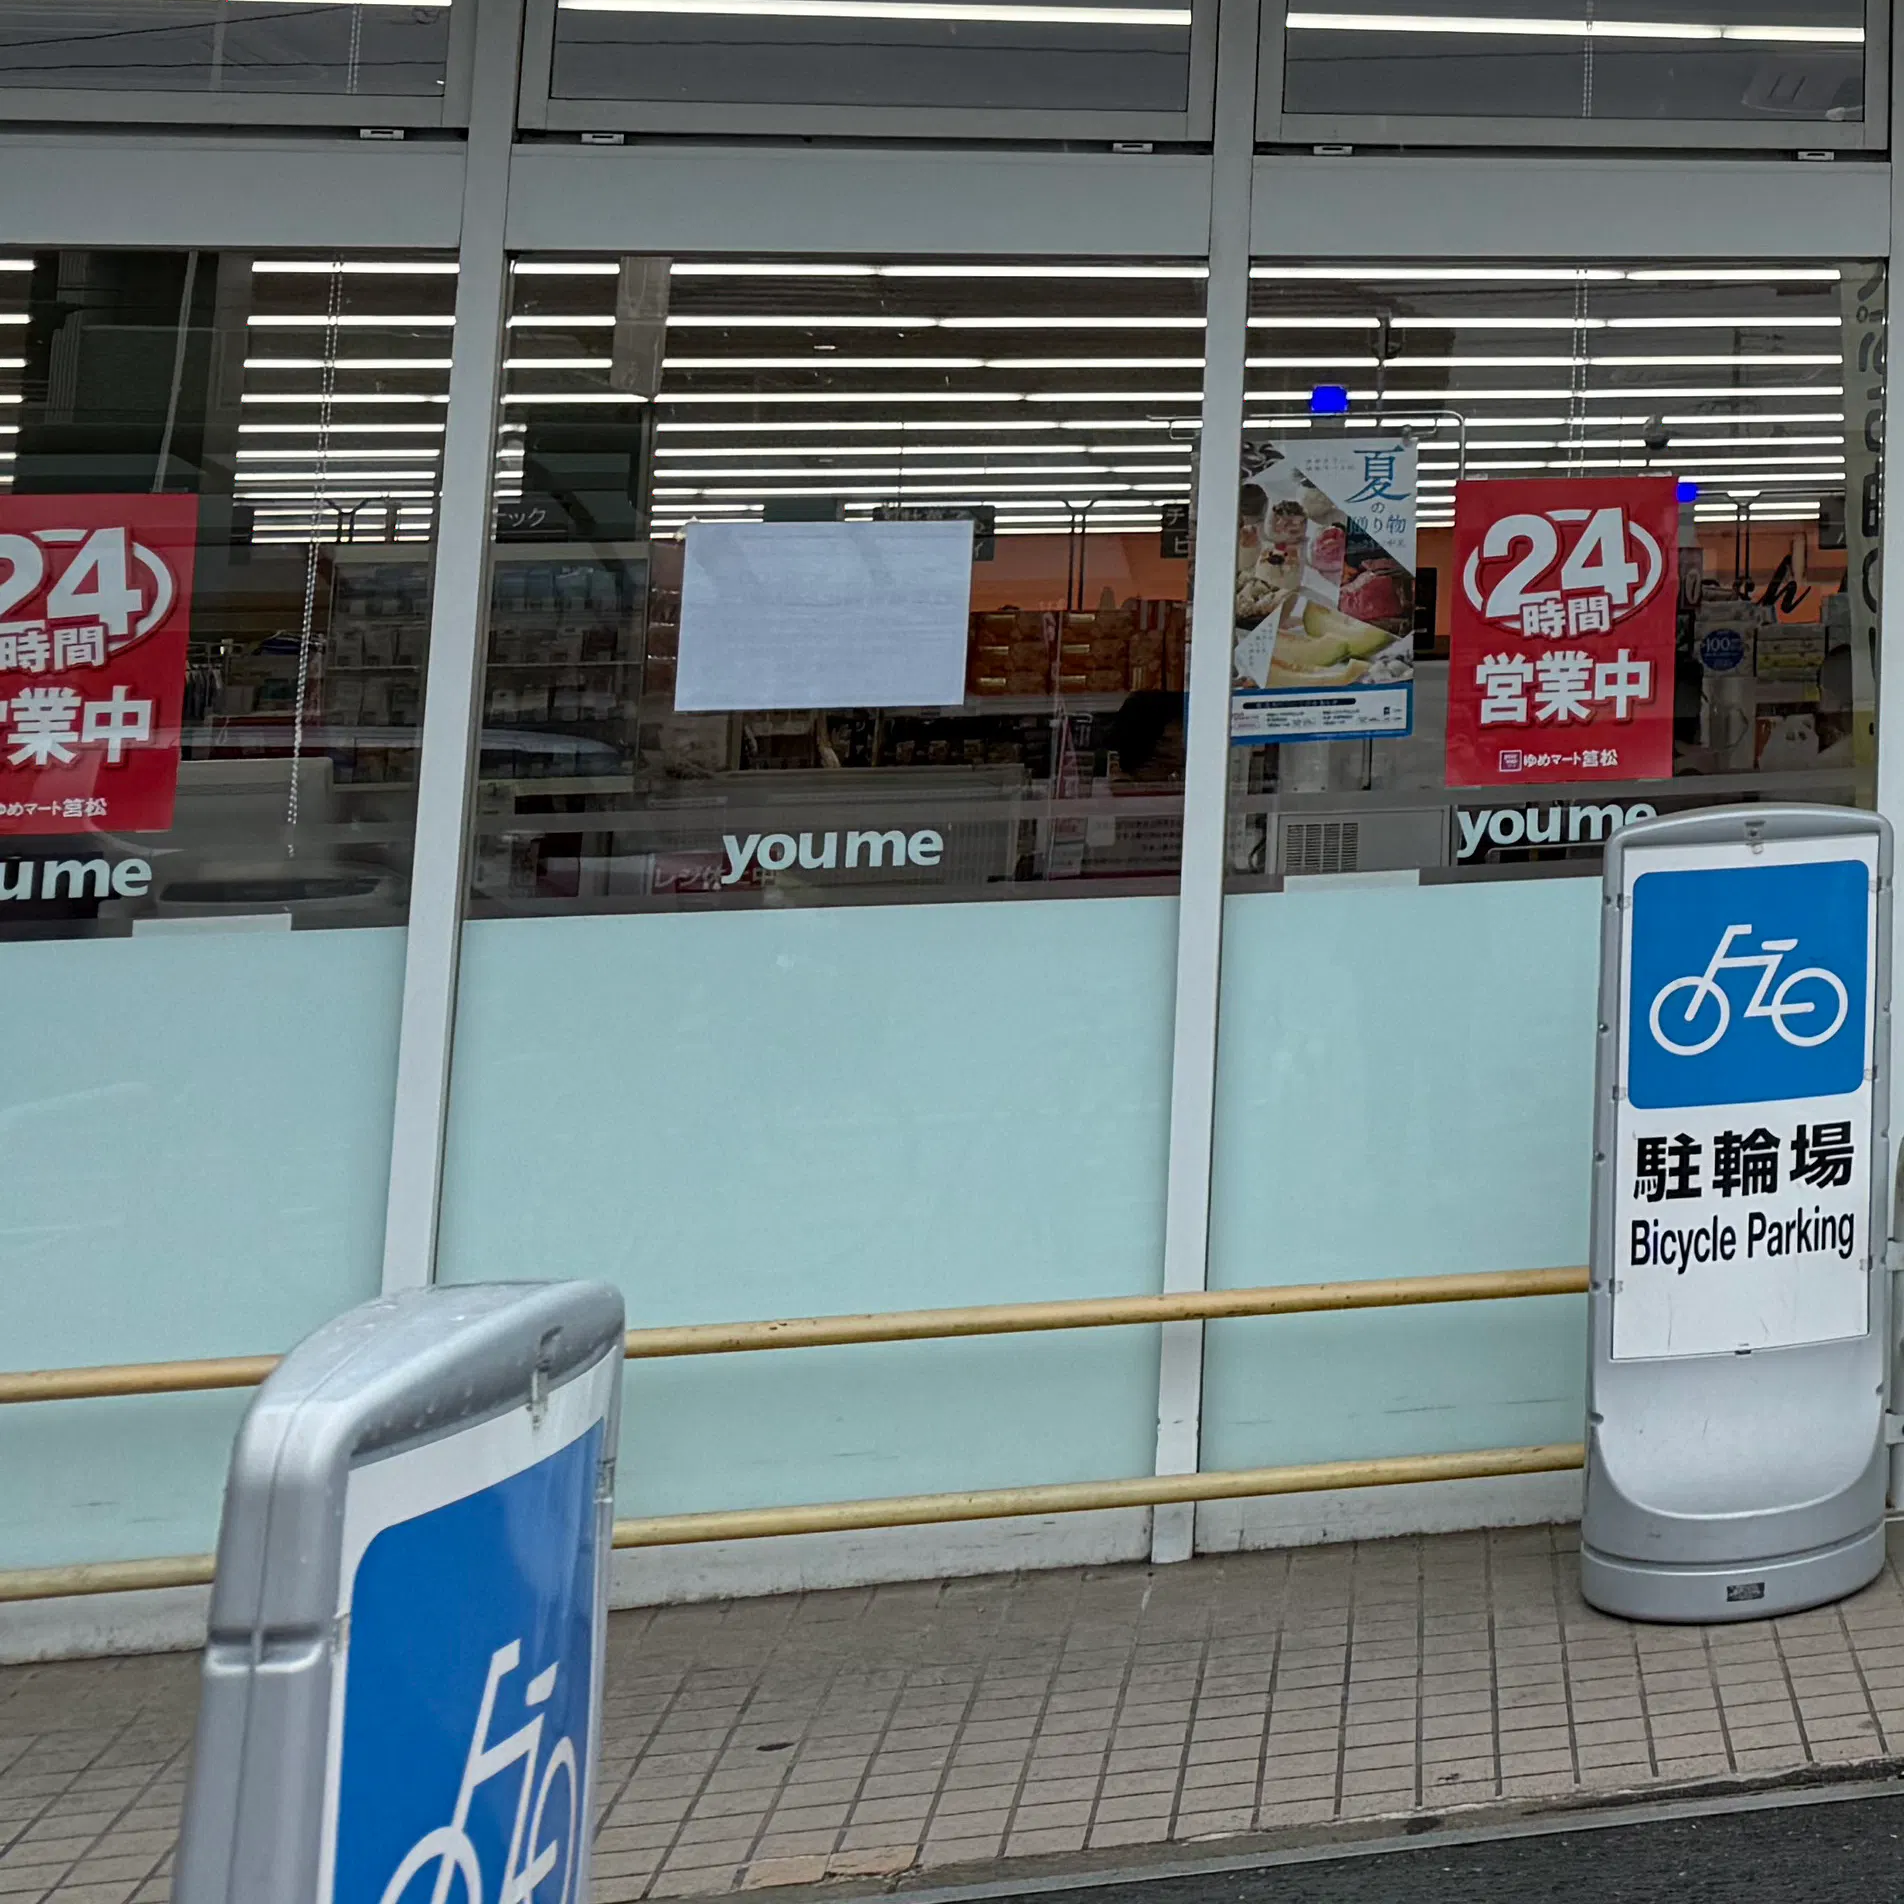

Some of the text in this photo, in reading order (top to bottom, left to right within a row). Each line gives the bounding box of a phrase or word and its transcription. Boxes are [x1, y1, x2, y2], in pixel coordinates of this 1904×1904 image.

[1345, 445, 1411, 504] 夏
[1483, 507, 1640, 619] 24
[0, 625, 108, 674] 時間
[1522, 596, 1610, 639] 時間
[1475, 648, 1651, 725] 営業中
[0, 685, 154, 767] 業中
[1523, 748, 1619, 769] ゆめマート筥松
[722, 829, 944, 885] youme
[1633, 1120, 1855, 1203] 駐輪場
[1630, 1205, 1855, 1276] Bicycle Parking
